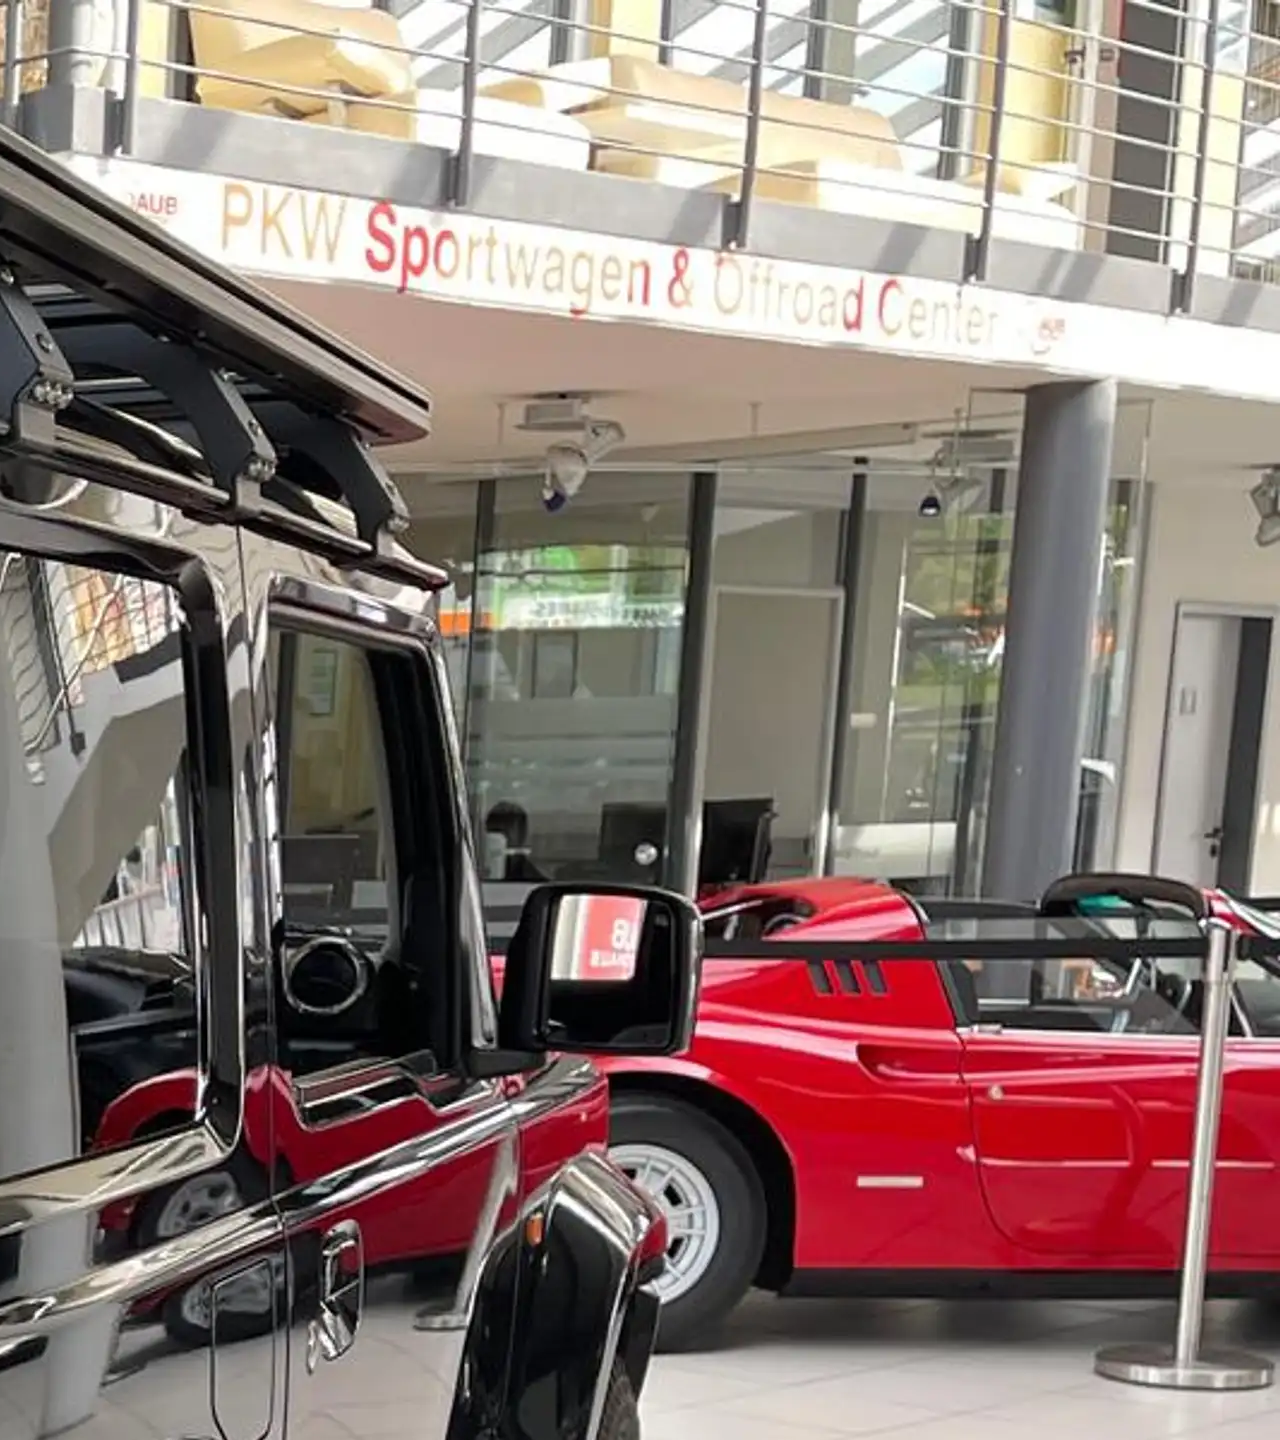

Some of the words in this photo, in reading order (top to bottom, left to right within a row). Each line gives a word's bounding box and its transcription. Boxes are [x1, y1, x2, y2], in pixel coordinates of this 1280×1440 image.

[220, 183, 349, 263] PKW
[365, 199, 651, 317] Sportwagen
[667, 246, 695, 308] &
[713, 252, 865, 333] Offroad
[878, 278, 1000, 346] Center
